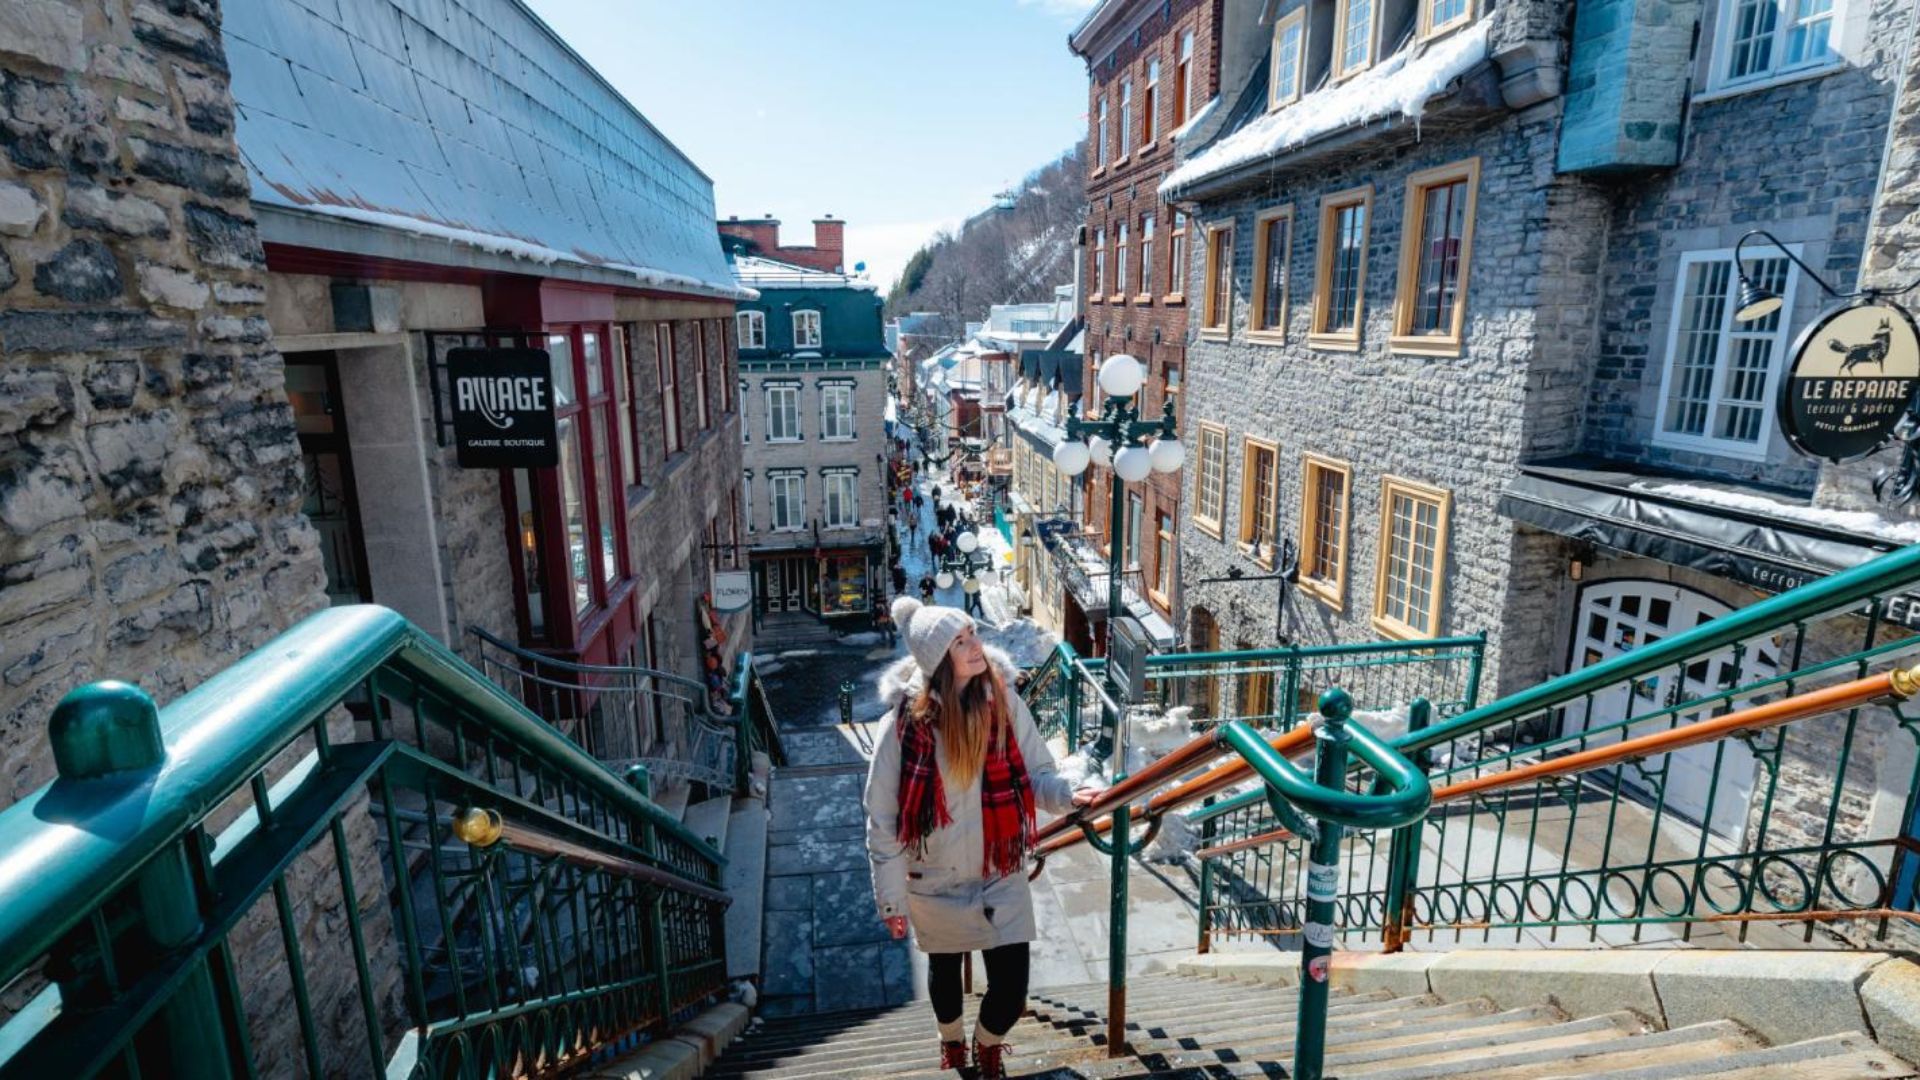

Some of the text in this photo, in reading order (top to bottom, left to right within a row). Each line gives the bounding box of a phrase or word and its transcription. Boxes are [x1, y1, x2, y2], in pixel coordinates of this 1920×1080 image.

[1802, 380, 1910, 399] LE REPAIRE
[1807, 403, 1845, 414] terroir
[1862, 403, 1894, 415] apéro
[1815, 421, 1836, 431] PETIT
[468, 439, 545, 447] GALERIE BOUTIQUE
